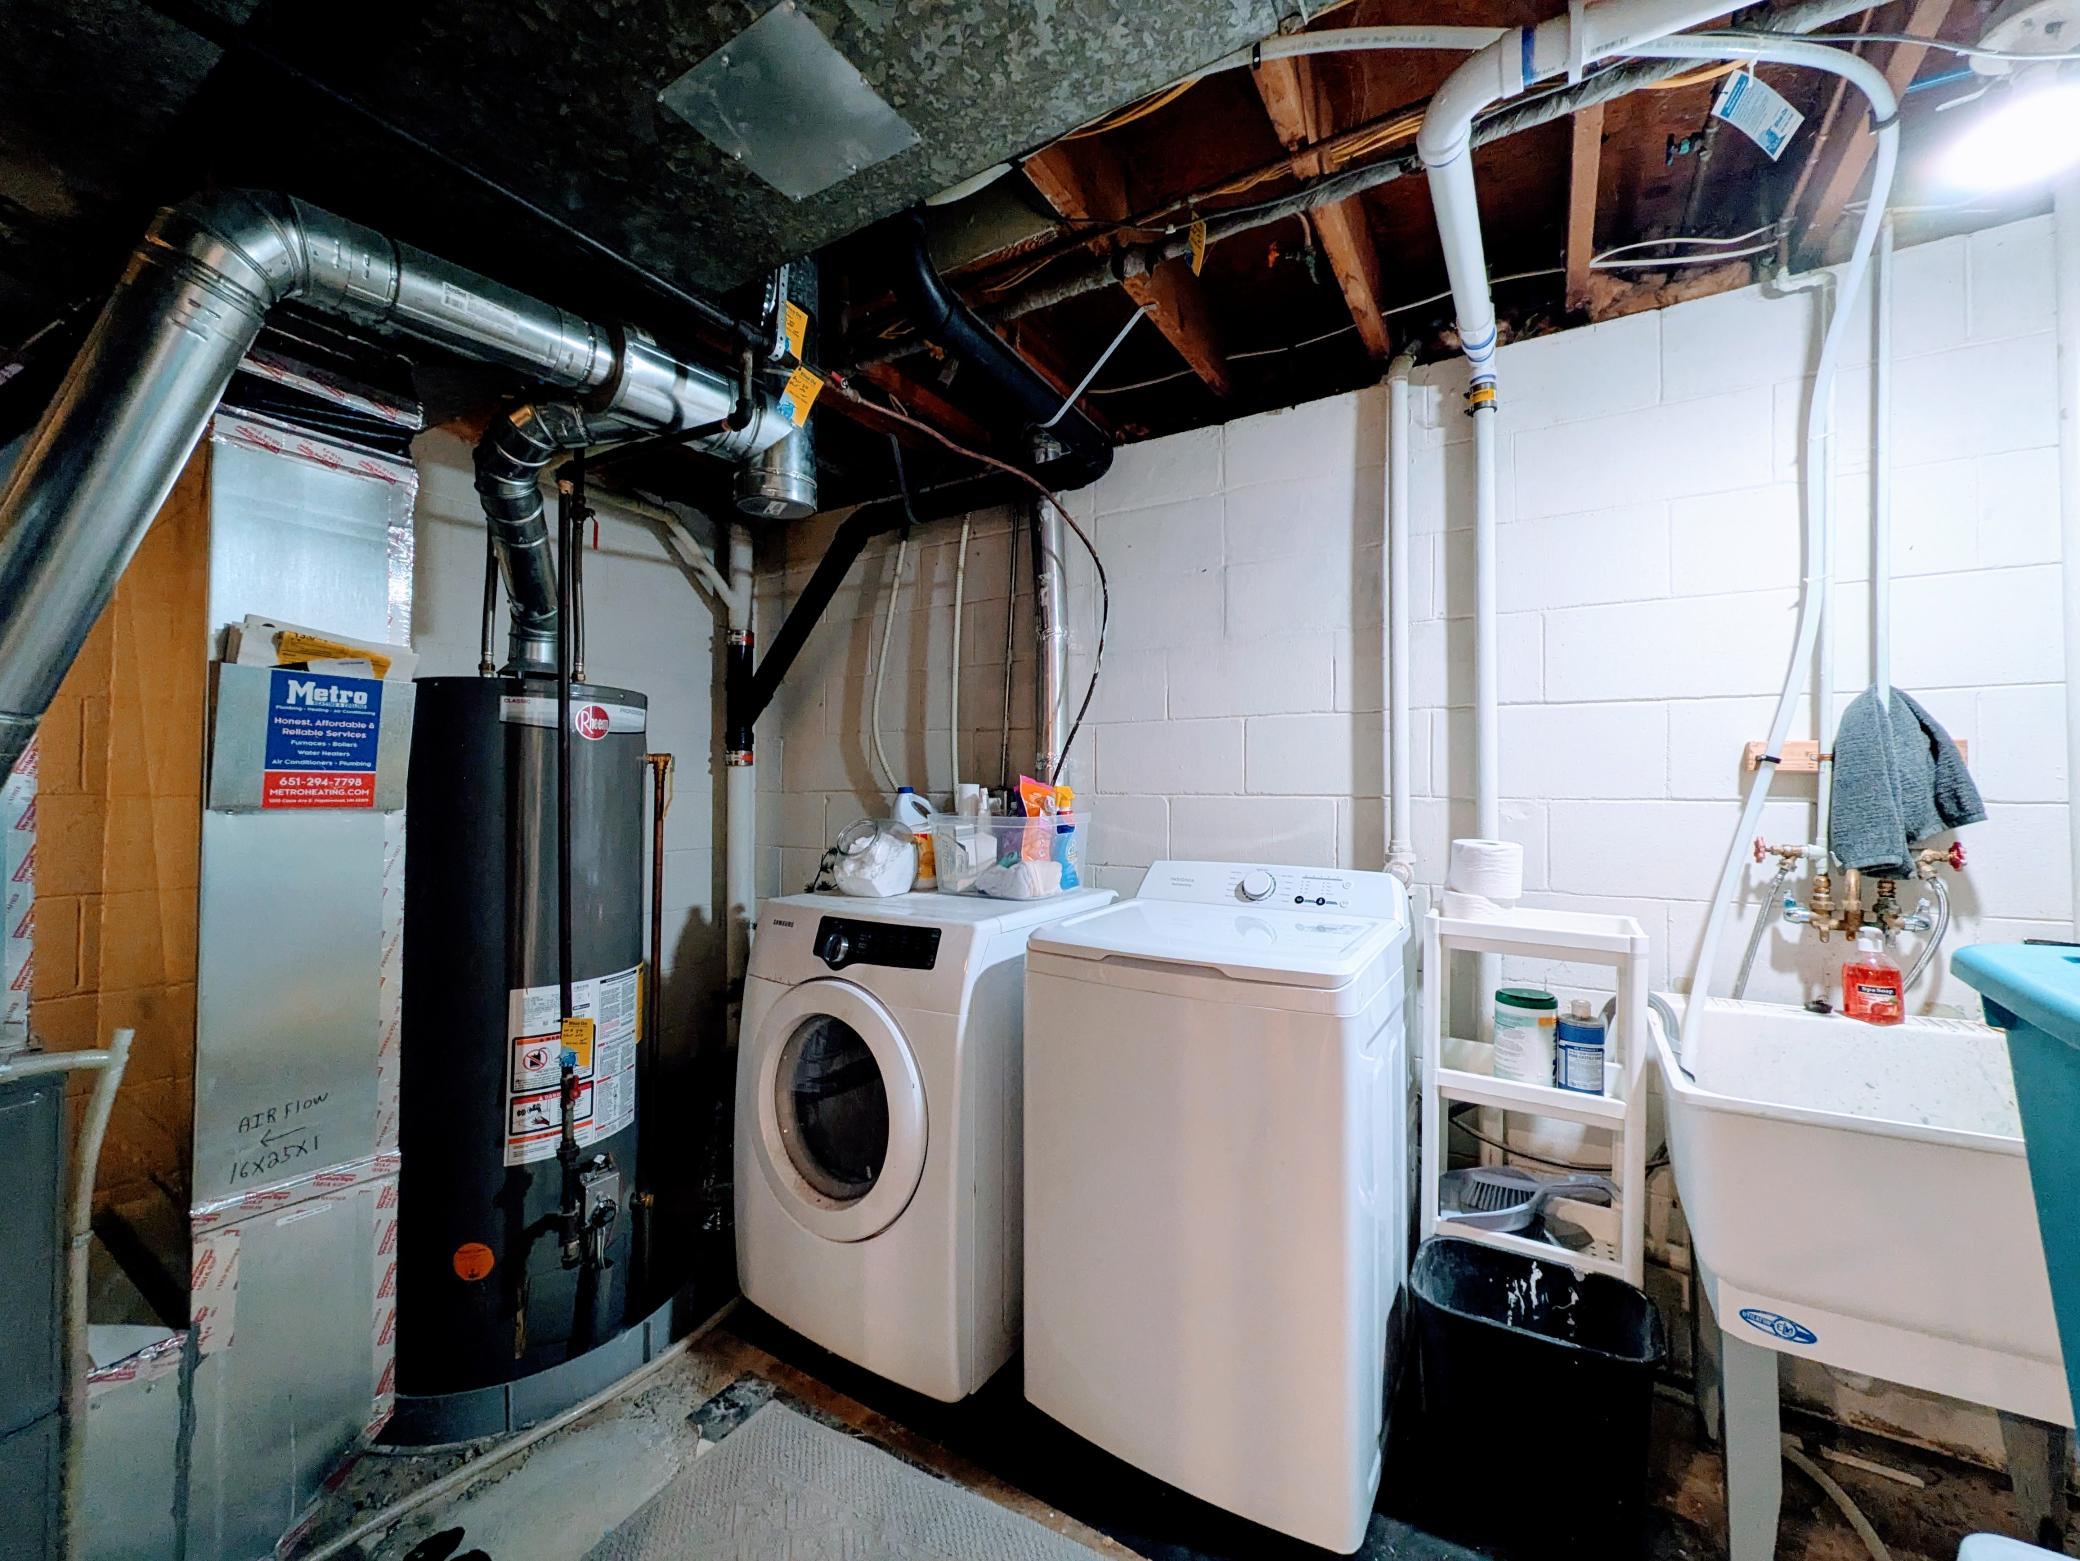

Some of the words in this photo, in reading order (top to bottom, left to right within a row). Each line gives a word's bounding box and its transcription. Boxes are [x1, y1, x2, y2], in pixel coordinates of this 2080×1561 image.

[286, 680, 368, 706] Metro
[274, 717, 313, 726] Honest,
[315, 720, 367, 729] Affordable
[580, 705, 609, 734] Rheem
[282, 728, 323, 737] Reliable
[326, 730, 367, 739] Services
[338, 760, 372, 768] Plumbing
[279, 777, 362, 786] 651-294-7798
[269, 788, 370, 796] METROHEATING.COM
[772, 919, 795, 928] SAMSUNG
[1876, 987, 1894, 995] Soap
[238, 1107, 277, 1133] AIR
